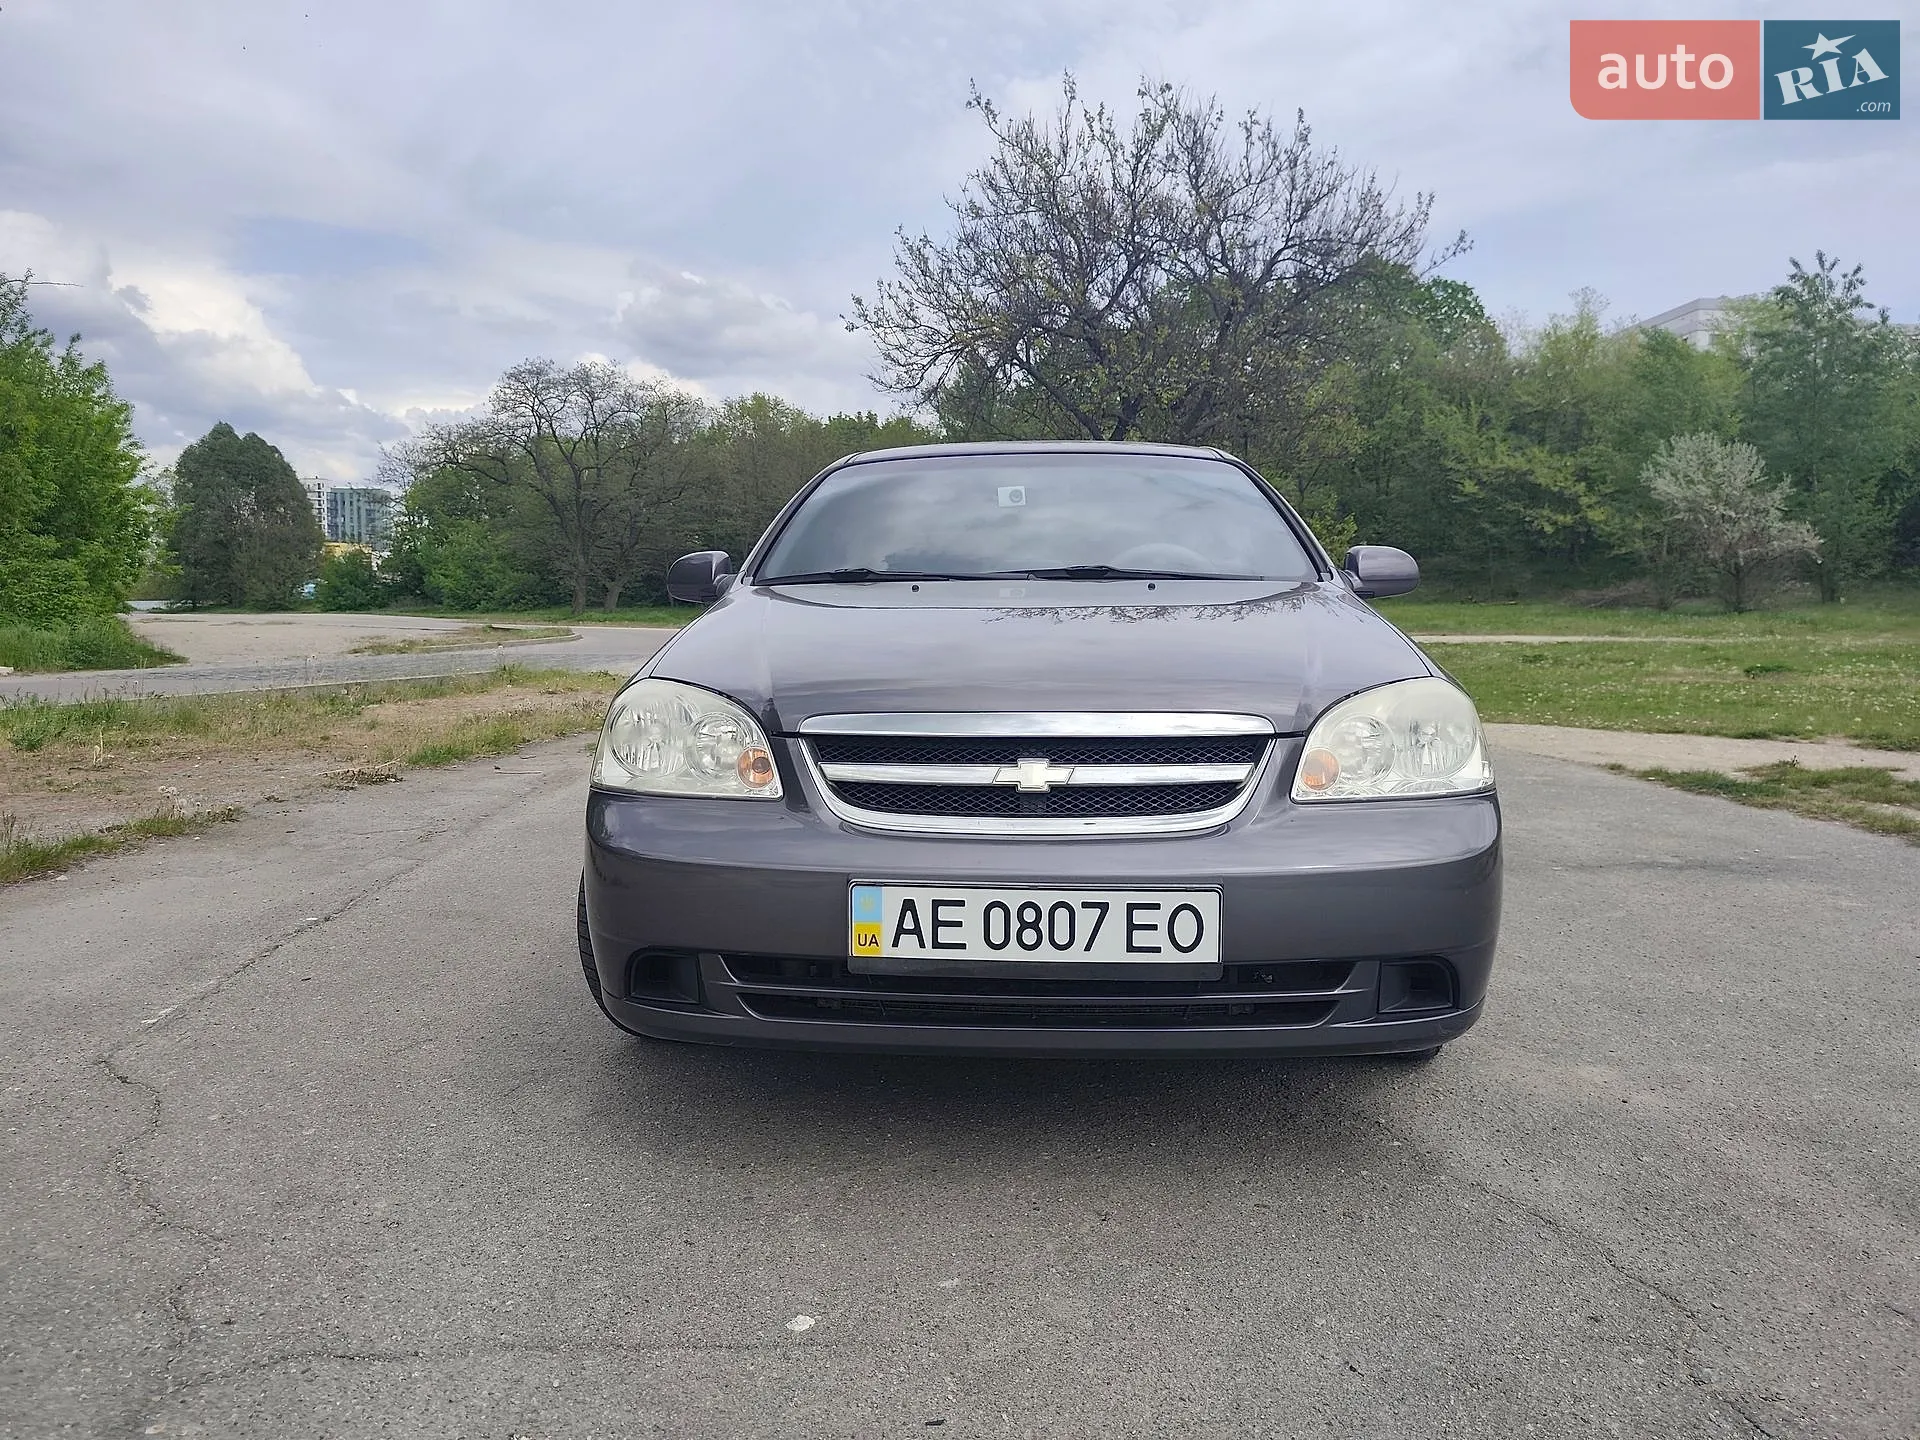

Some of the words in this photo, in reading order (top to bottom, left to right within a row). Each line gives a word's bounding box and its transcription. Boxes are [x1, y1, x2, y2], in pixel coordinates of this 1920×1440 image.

[856, 933, 880, 948] UA
[891, 898, 967, 950] AE
[982, 899, 1110, 952] 0807
[1125, 902, 1205, 954] EO
